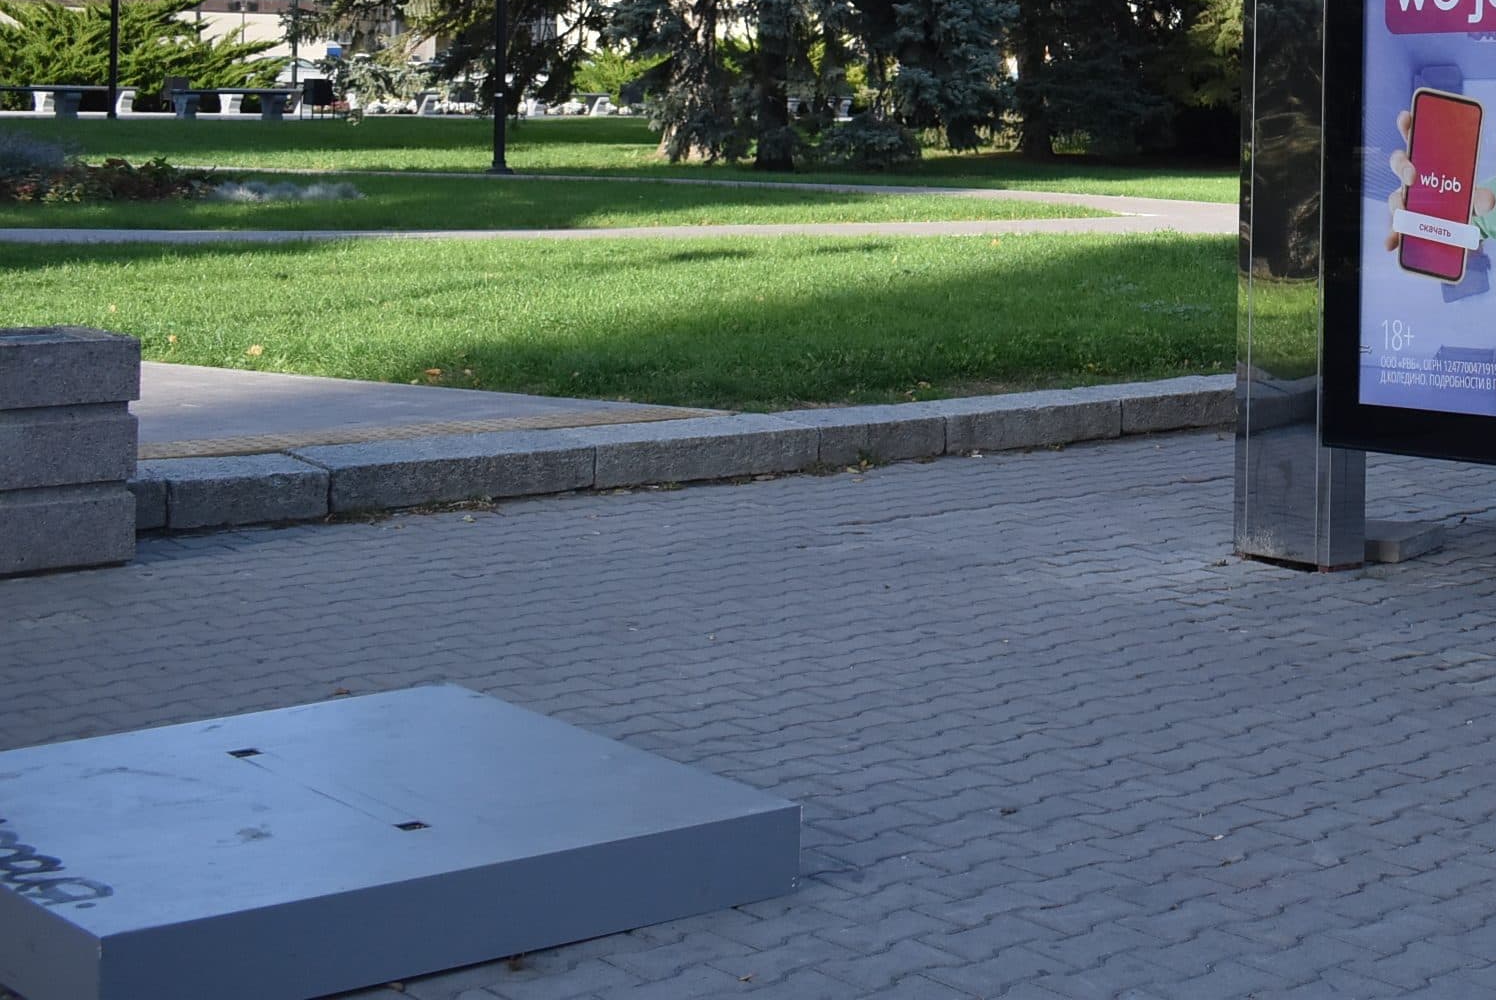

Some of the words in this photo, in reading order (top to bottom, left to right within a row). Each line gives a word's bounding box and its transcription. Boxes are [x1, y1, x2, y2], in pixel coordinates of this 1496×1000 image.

[1420, 171, 1439, 188] wb
[1439, 173, 1462, 194] job
[1418, 222, 1452, 238] скачать
[1381, 319, 1415, 351] 18+
[1429, 375, 1485, 390] ПОДРОБНОСТИ
